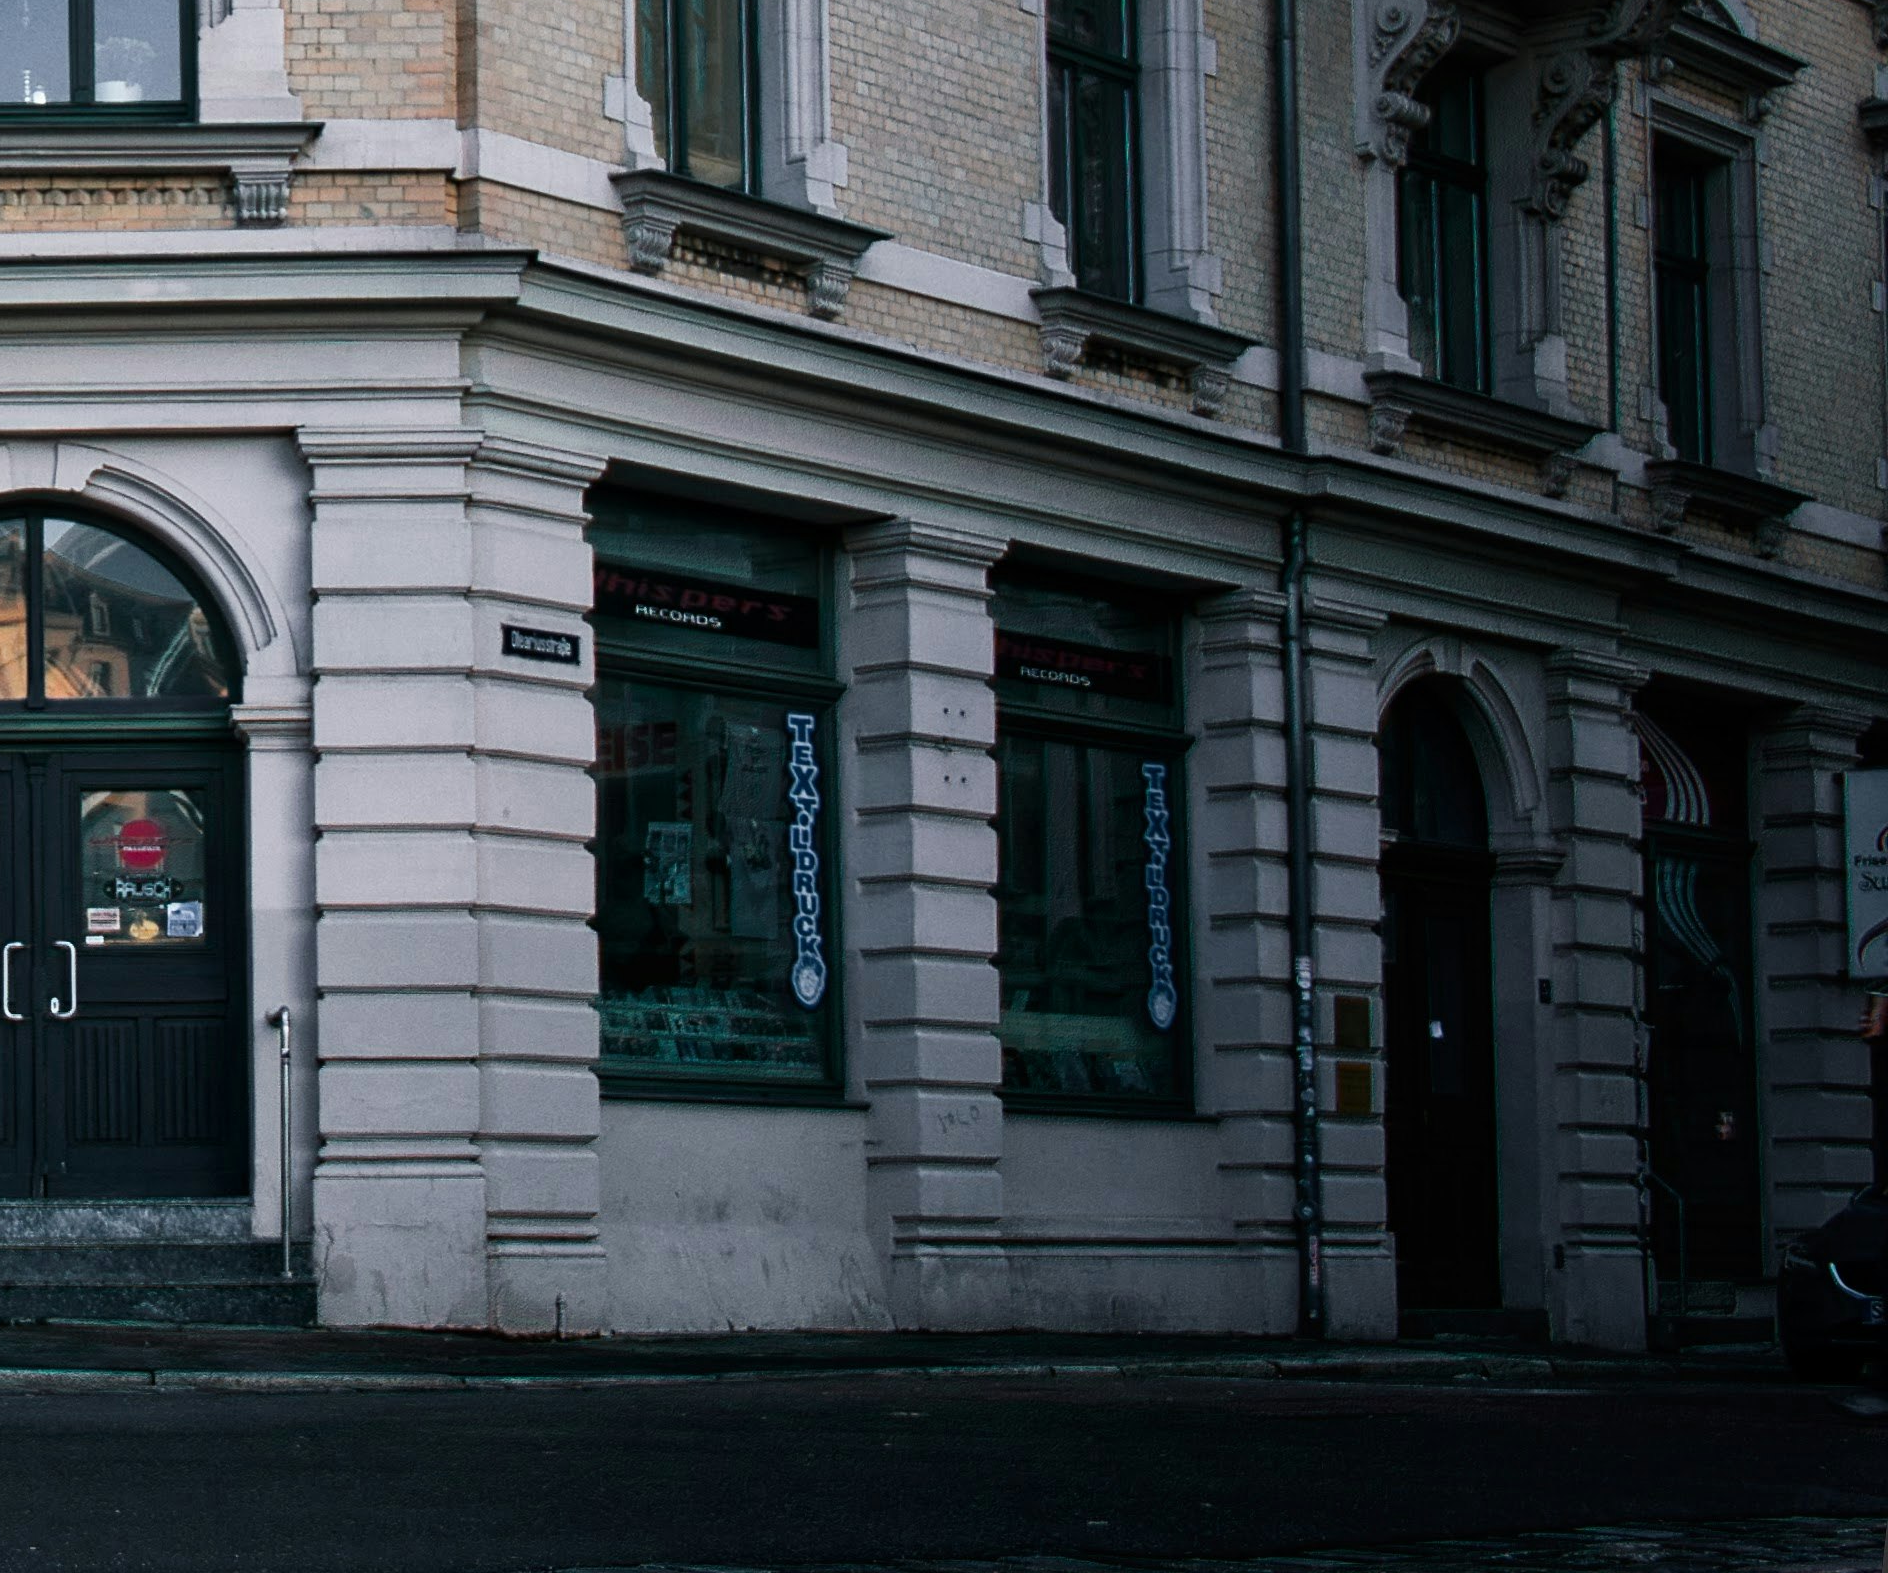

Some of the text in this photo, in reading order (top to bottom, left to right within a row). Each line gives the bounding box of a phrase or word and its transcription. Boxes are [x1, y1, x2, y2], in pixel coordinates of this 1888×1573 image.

[634, 603, 723, 630] RECORDS
[1019, 665, 1092, 688] RECORDS
[786, 713, 824, 966] TEXTILDRUCK
[1142, 763, 1174, 990] TEXTILDRUCK
